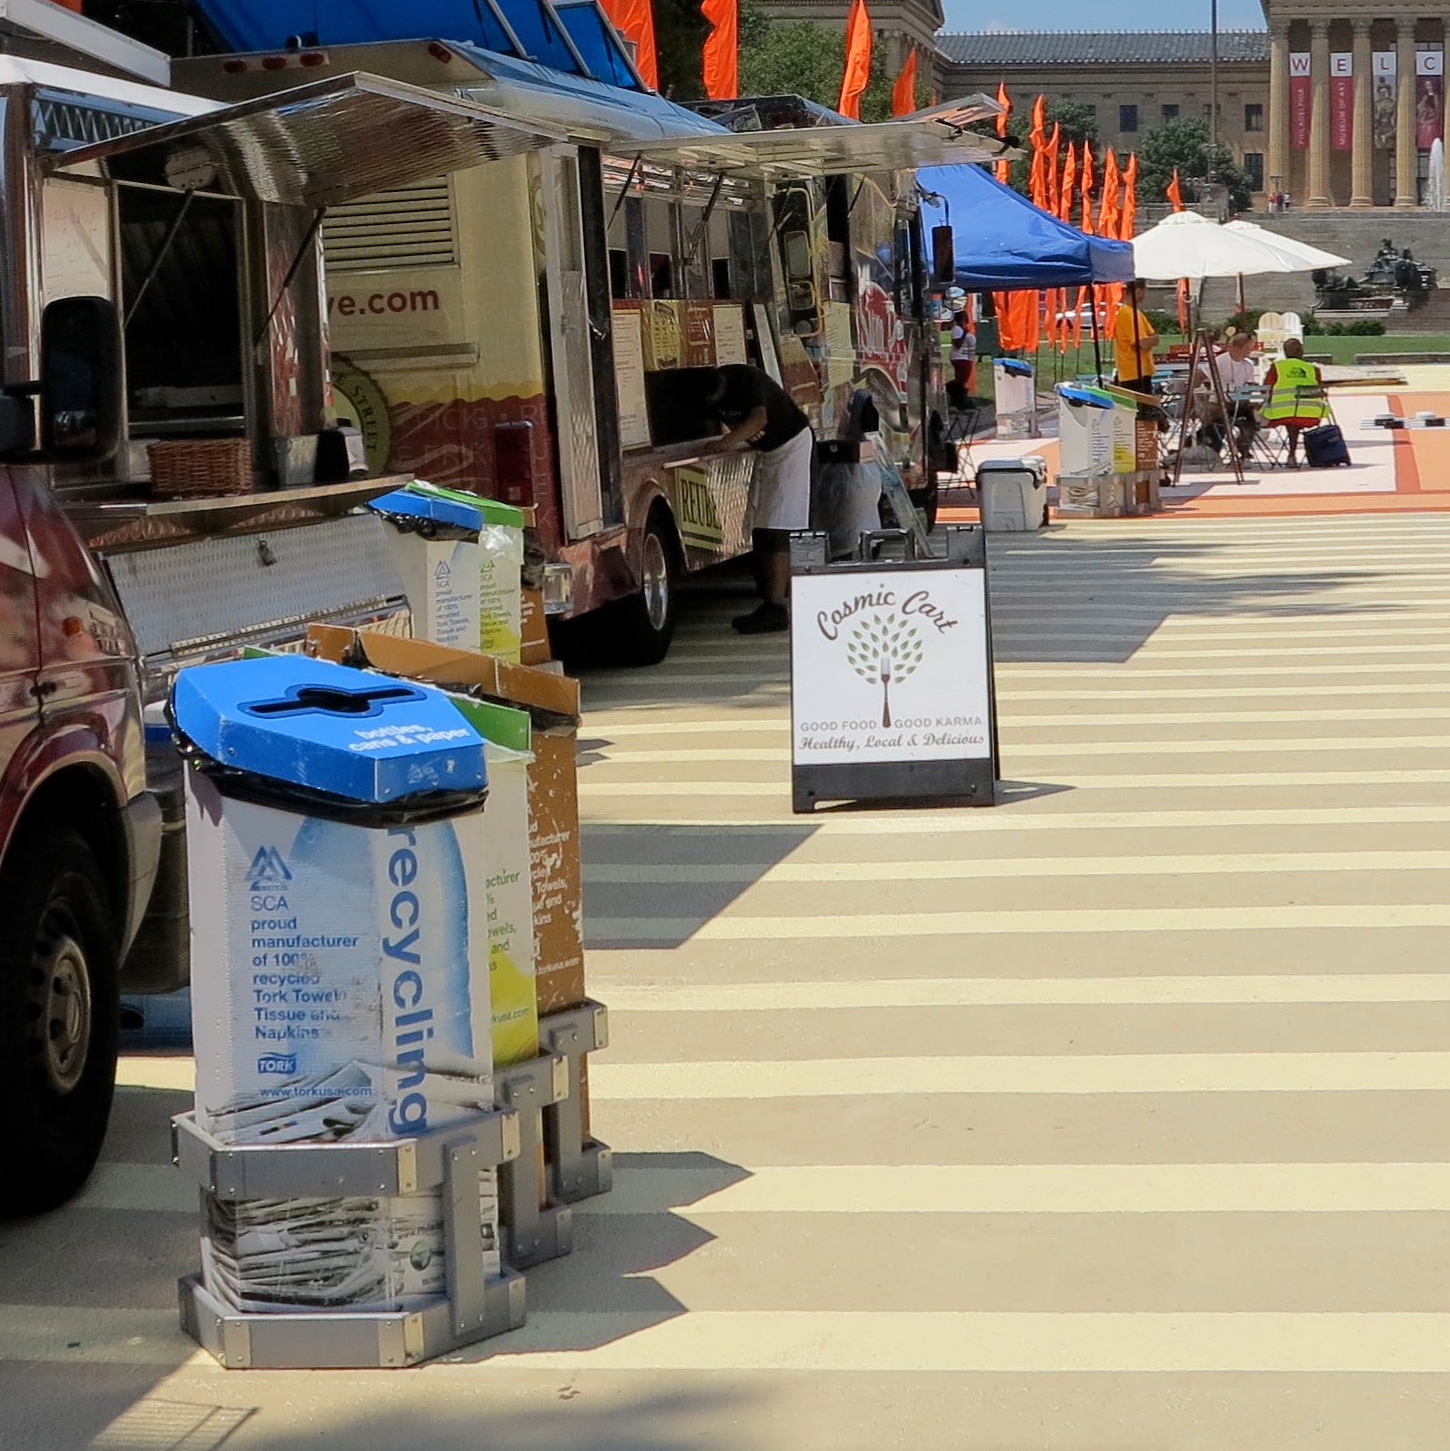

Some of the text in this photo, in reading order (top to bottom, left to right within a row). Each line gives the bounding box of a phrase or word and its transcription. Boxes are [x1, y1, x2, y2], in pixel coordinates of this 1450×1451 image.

[817, 583, 958, 641] Cosmic Cart
[800, 721, 838, 732] GOOD
[894, 718, 933, 729] GOOD
[799, 732, 985, 752] Healthy, Local & Delicious
[251, 895, 289, 911] SCA
[251, 916, 298, 933] proud
[251, 935, 360, 949] manufacturer
[252, 953, 267, 967] of
[382, 826, 434, 1137] recycling
[253, 989, 288, 1003] Tork
[254, 1007, 306, 1021] Tissue
[259, 1059, 294, 1073] TORK
[260, 1085, 372, 1098] www.torkusa.com
